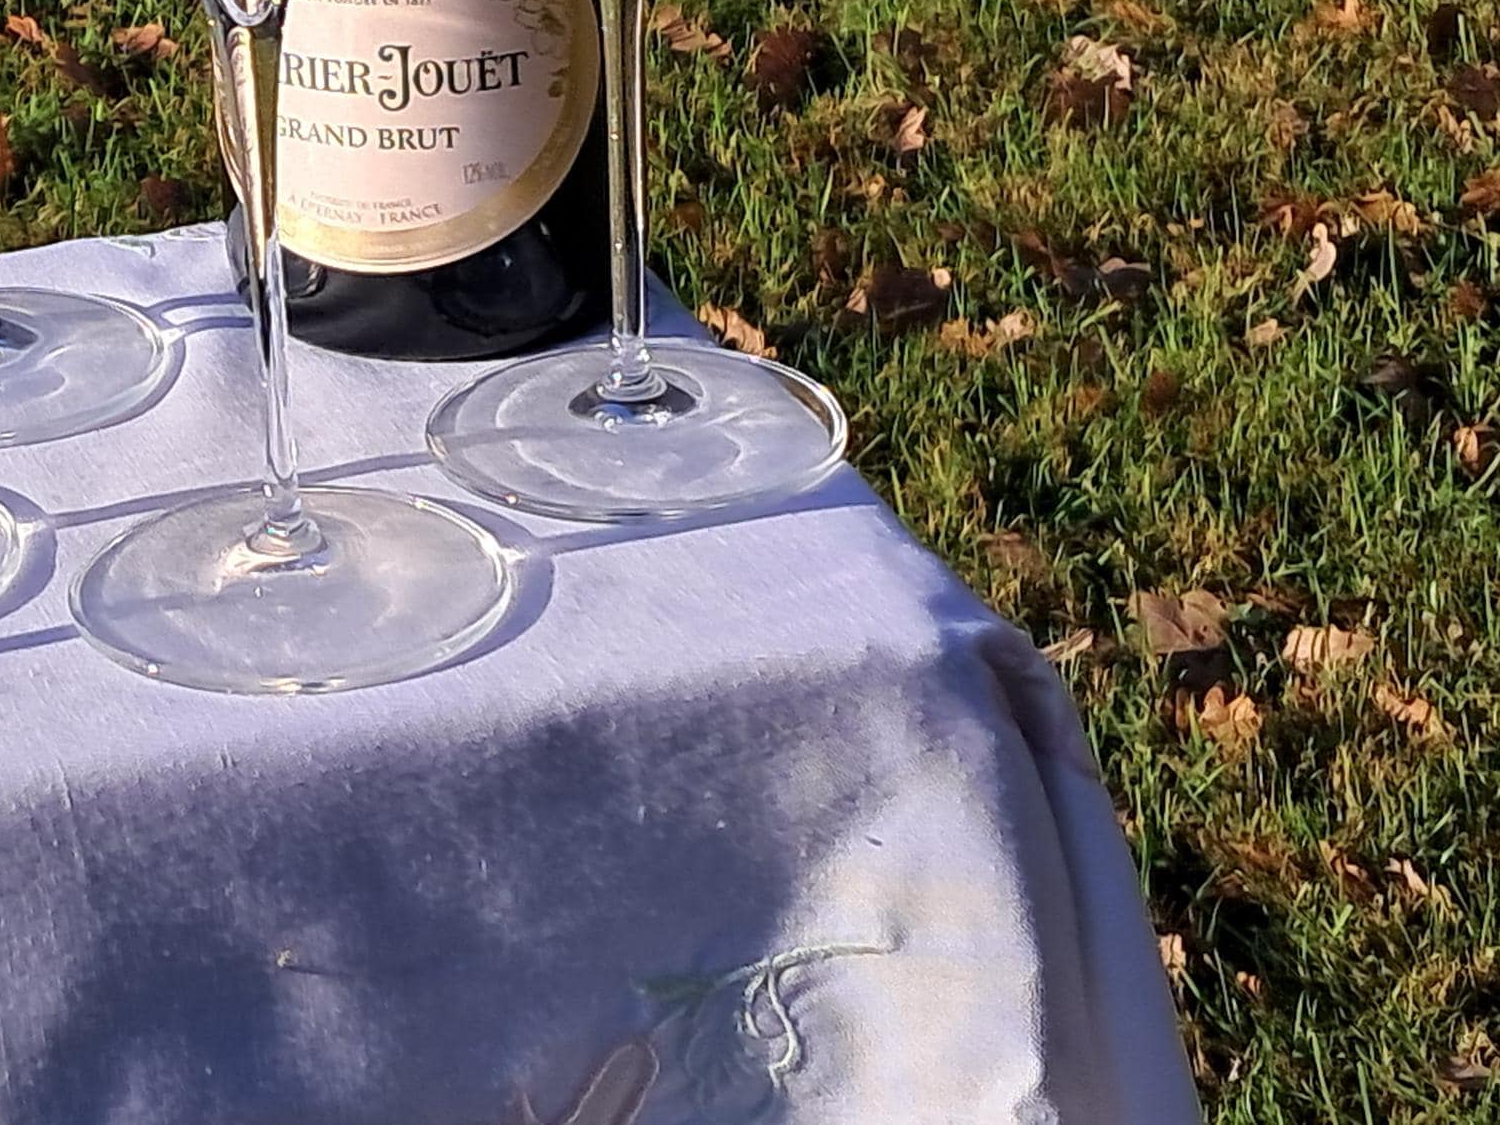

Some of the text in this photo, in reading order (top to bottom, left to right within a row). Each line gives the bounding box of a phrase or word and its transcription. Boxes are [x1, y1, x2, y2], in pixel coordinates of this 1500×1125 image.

[278, 44, 530, 112] RIER-JOUËT
[378, 127, 461, 151] BRUT
[380, 203, 444, 225] FRANCE
